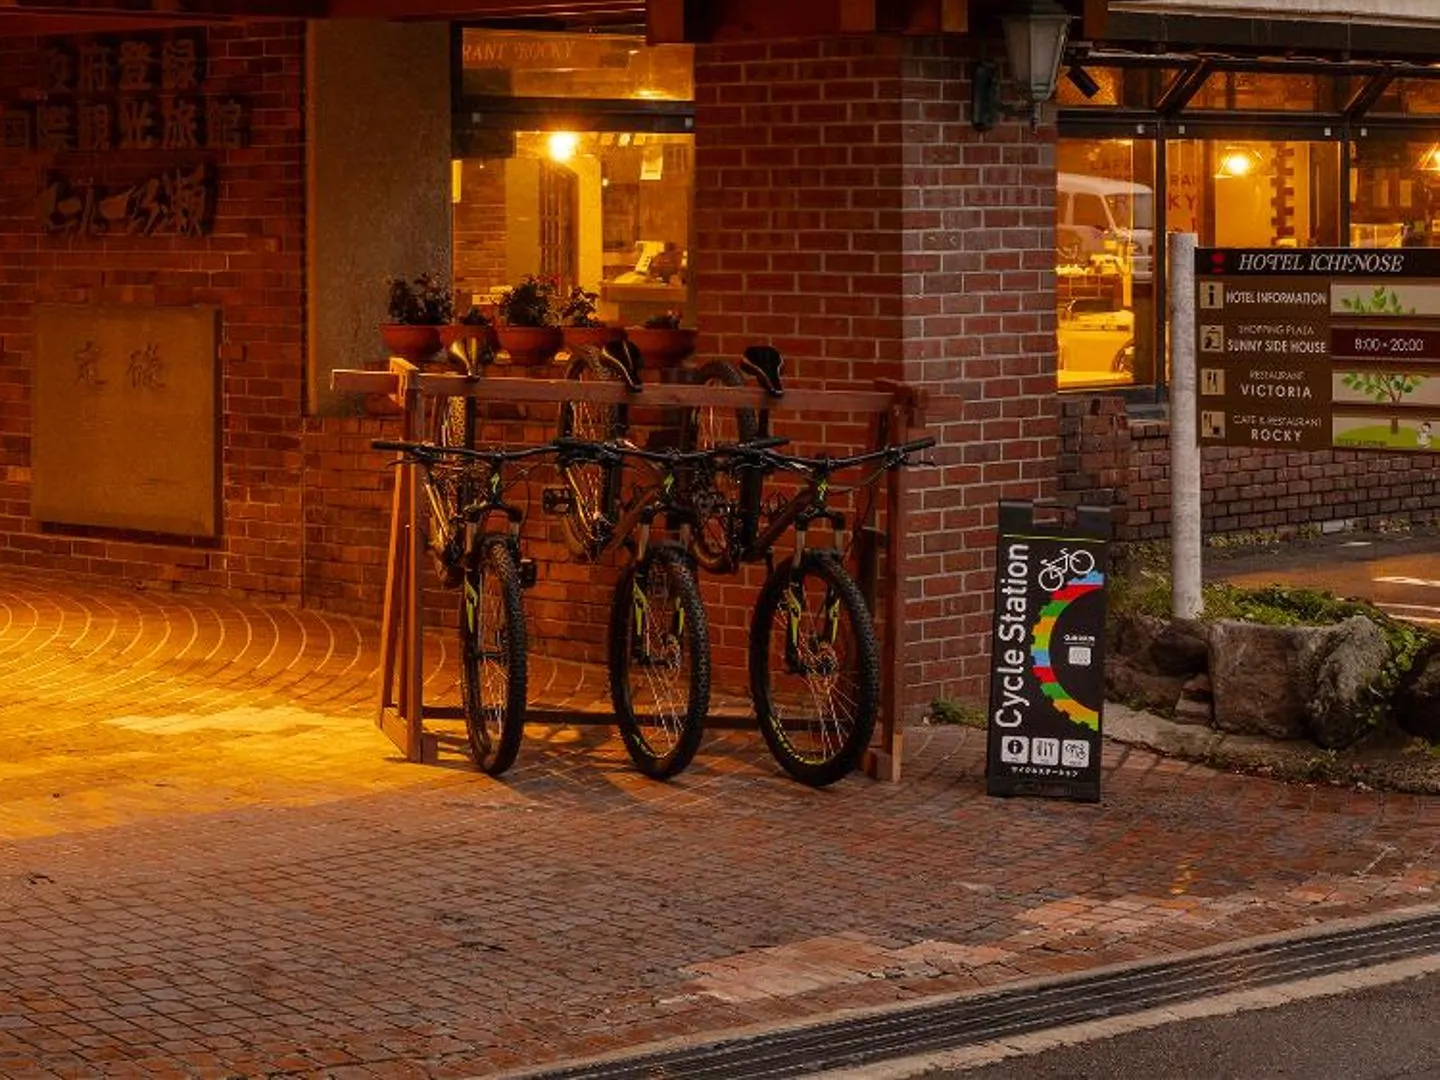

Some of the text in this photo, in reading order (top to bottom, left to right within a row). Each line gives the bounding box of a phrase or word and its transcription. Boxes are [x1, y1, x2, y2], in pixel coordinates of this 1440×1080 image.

[1238, 253, 1405, 273] HOTEL ICHINOSE
[1226, 290, 1328, 305] HOTEL INFORMATION
[1227, 338, 1327, 354] SUNNY SIDE HOUSE
[1239, 384, 1313, 399] VICTORIA
[1250, 428, 1303, 443] ROCKY
[995, 543, 1031, 728] Cycle Station
